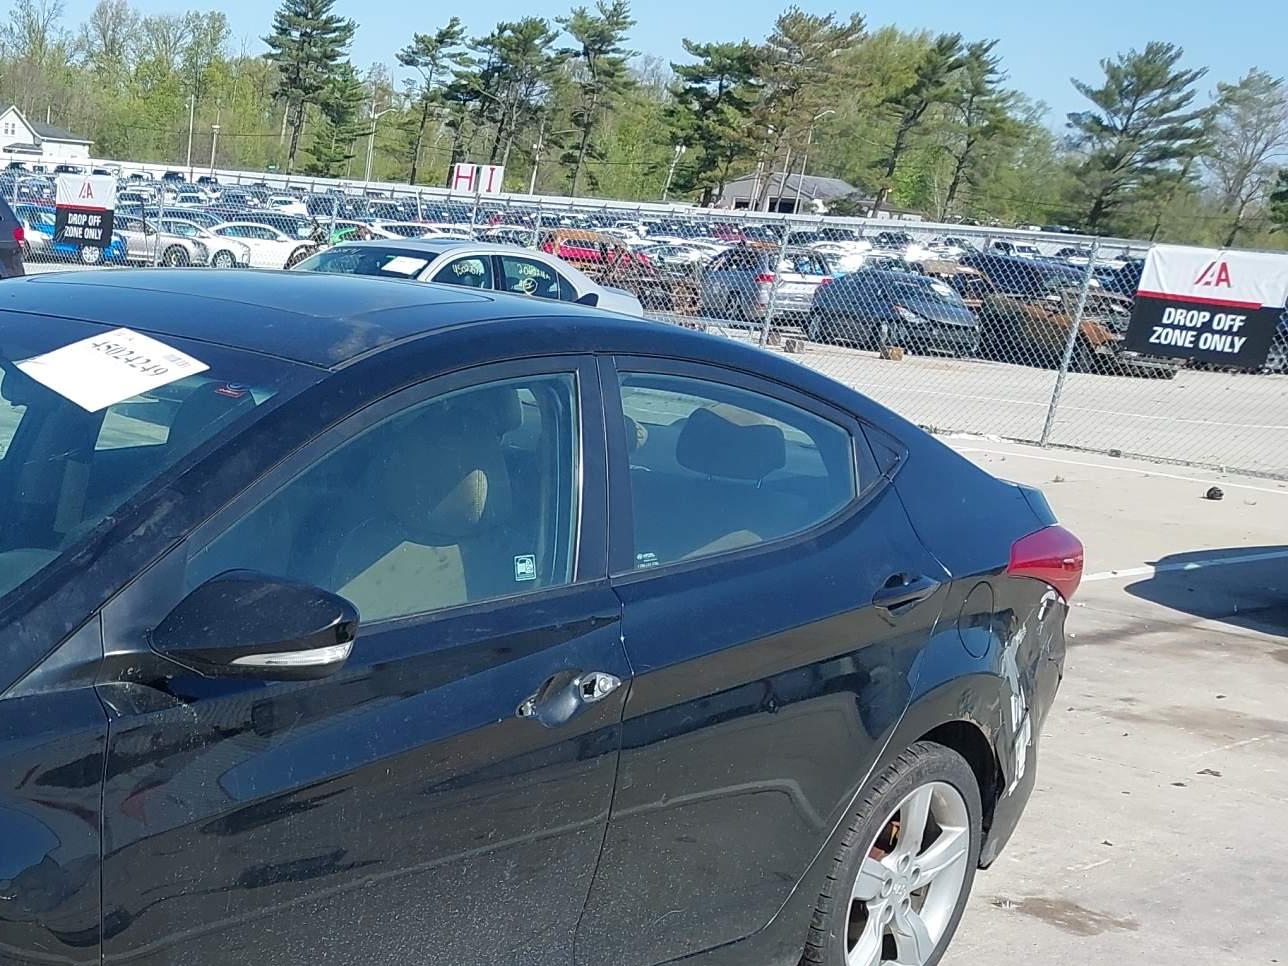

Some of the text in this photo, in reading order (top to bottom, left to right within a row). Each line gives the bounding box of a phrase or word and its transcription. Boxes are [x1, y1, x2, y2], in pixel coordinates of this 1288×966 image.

[67, 213, 102, 227] DROP OFF
[64, 225, 103, 240] ZONE ONLY
[1162, 307, 1247, 332] DROP OFF
[1149, 326, 1247, 354] ZONE ONLY
